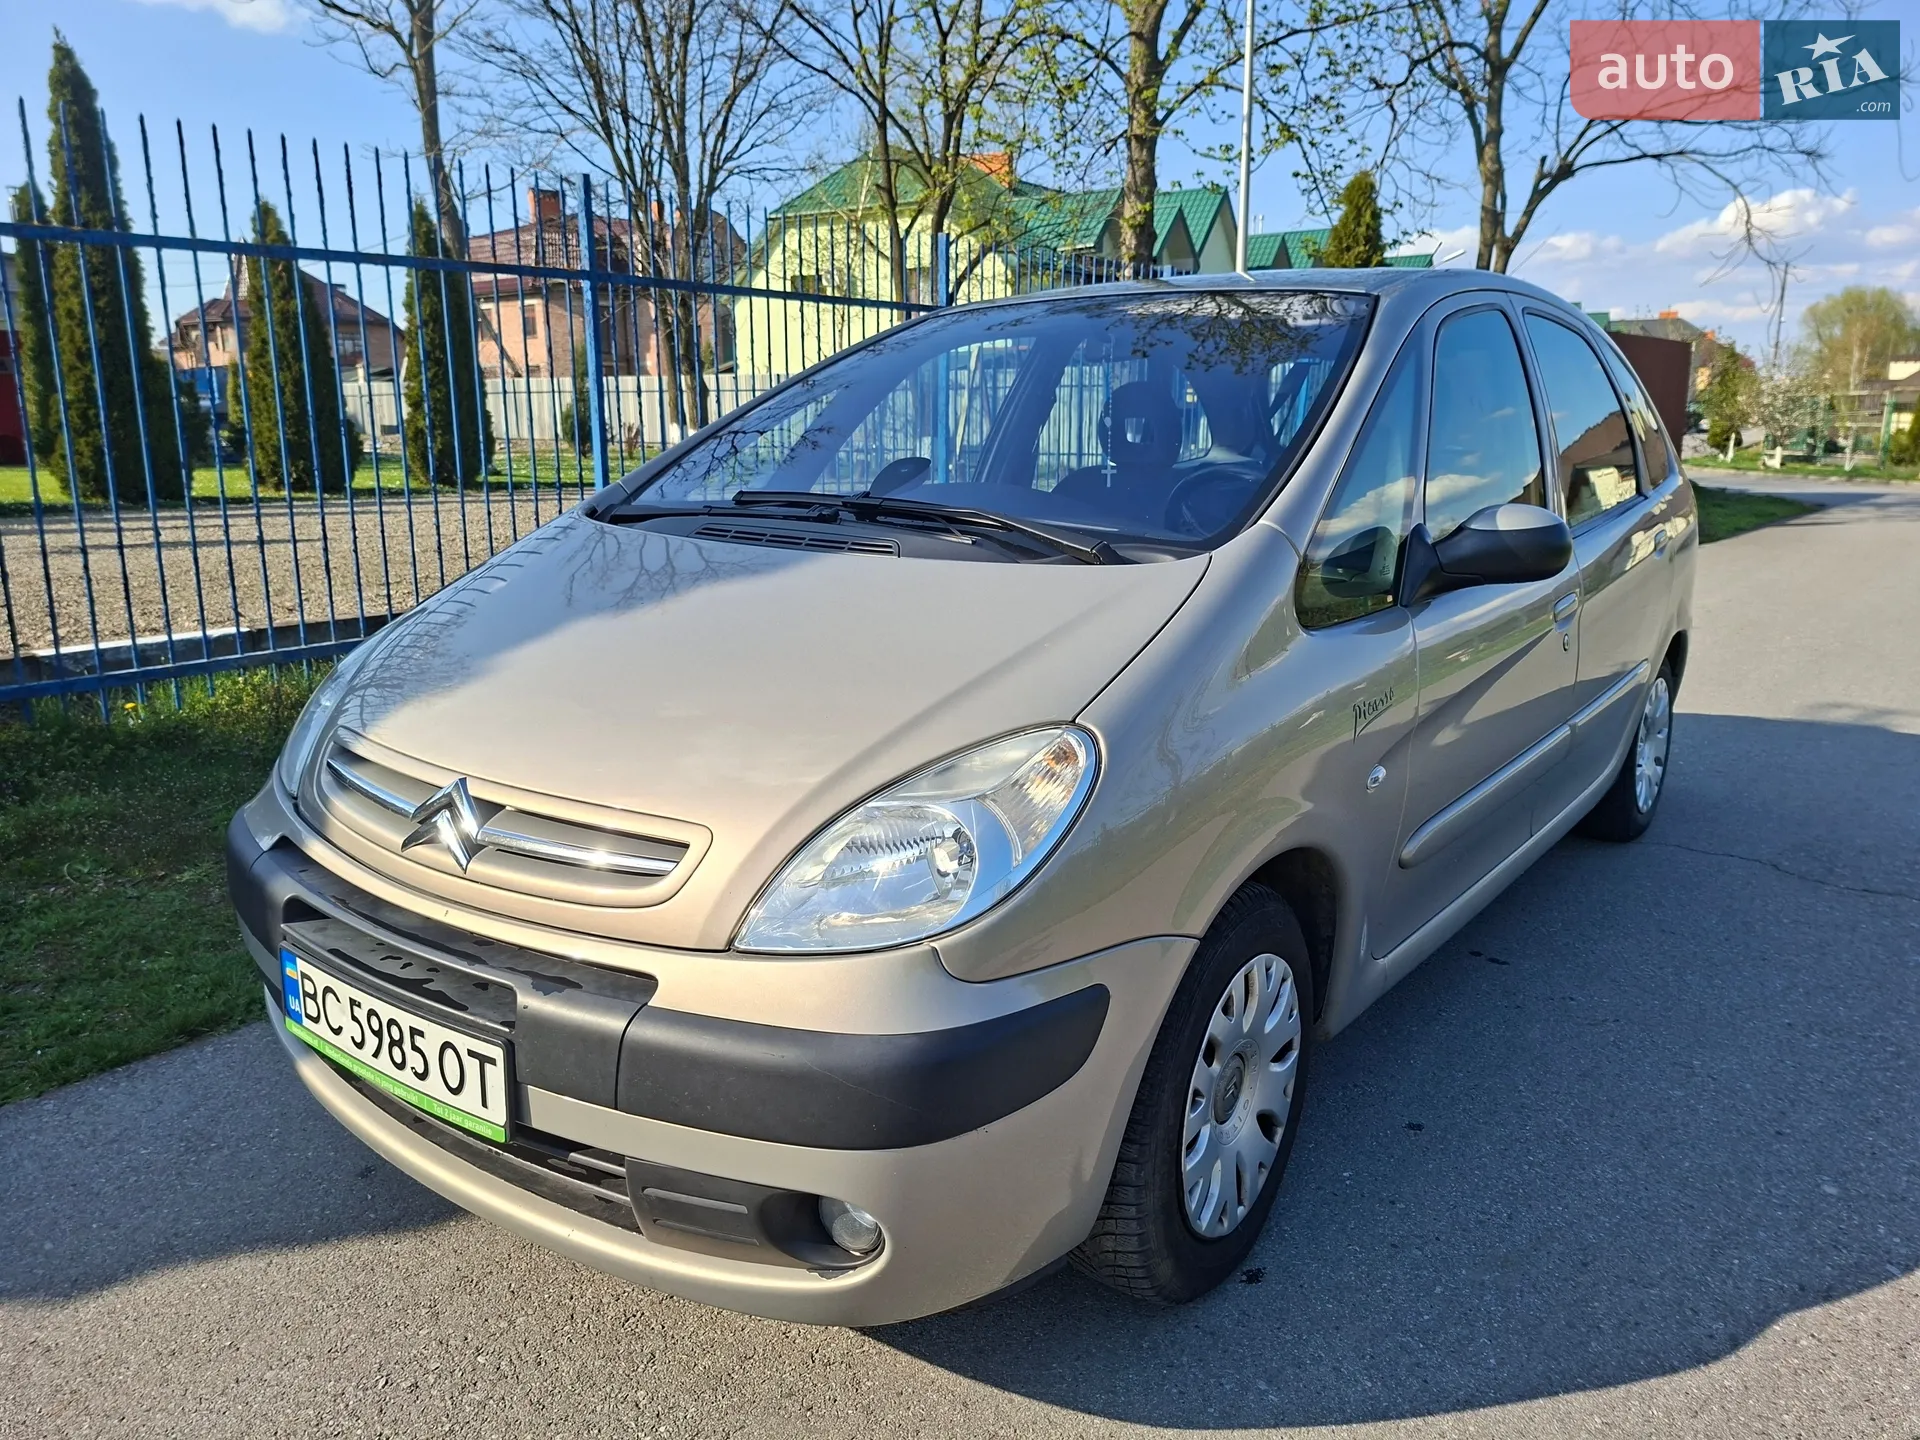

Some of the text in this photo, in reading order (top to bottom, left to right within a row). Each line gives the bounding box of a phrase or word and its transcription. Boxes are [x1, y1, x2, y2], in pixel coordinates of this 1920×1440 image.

[288, 994, 301, 1014] UA
[300, 969, 497, 1109] BC 5985 OT
[445, 1108, 449, 1117] 2
[449, 1111, 462, 1122] jaar
